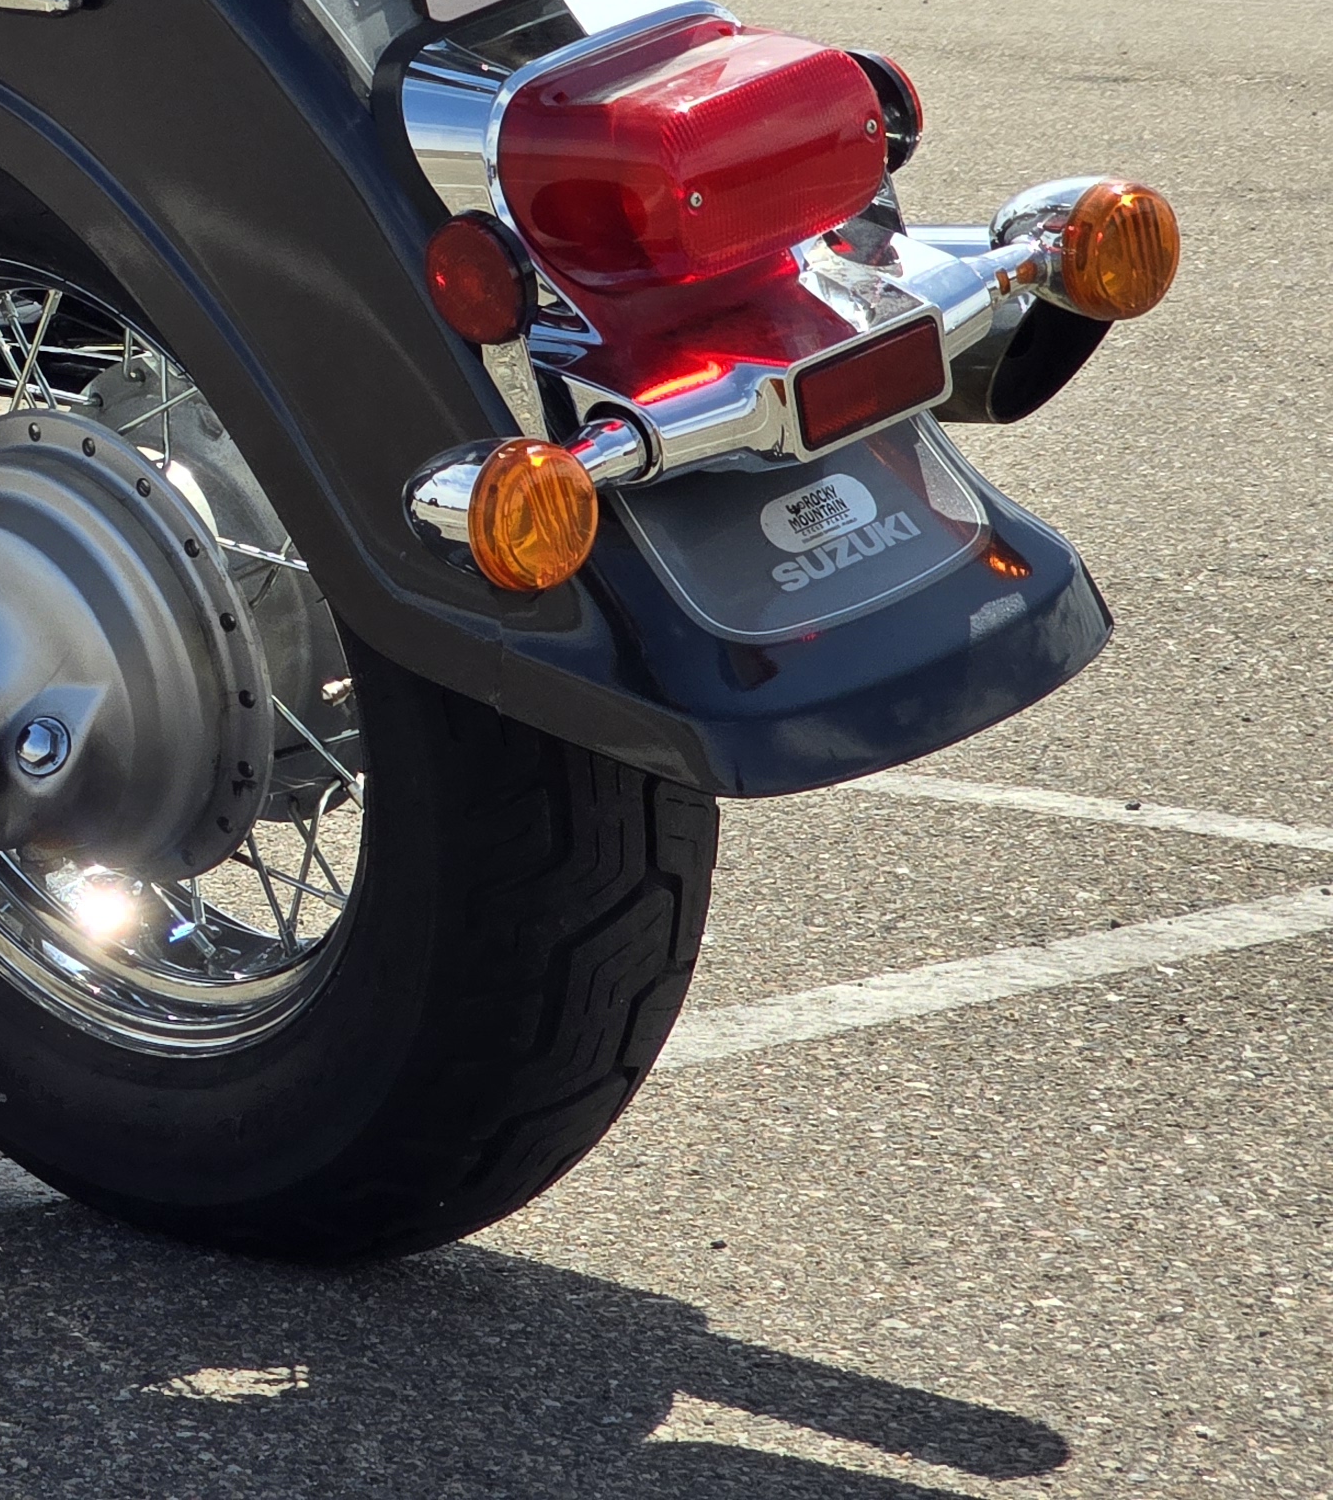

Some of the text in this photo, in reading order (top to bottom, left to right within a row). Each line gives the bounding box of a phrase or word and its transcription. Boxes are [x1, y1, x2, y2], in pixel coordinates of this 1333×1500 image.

[788, 497, 848, 531] MOUNTAIN
[802, 484, 839, 510] ROCKY
[771, 511, 922, 592] SUZUKI
